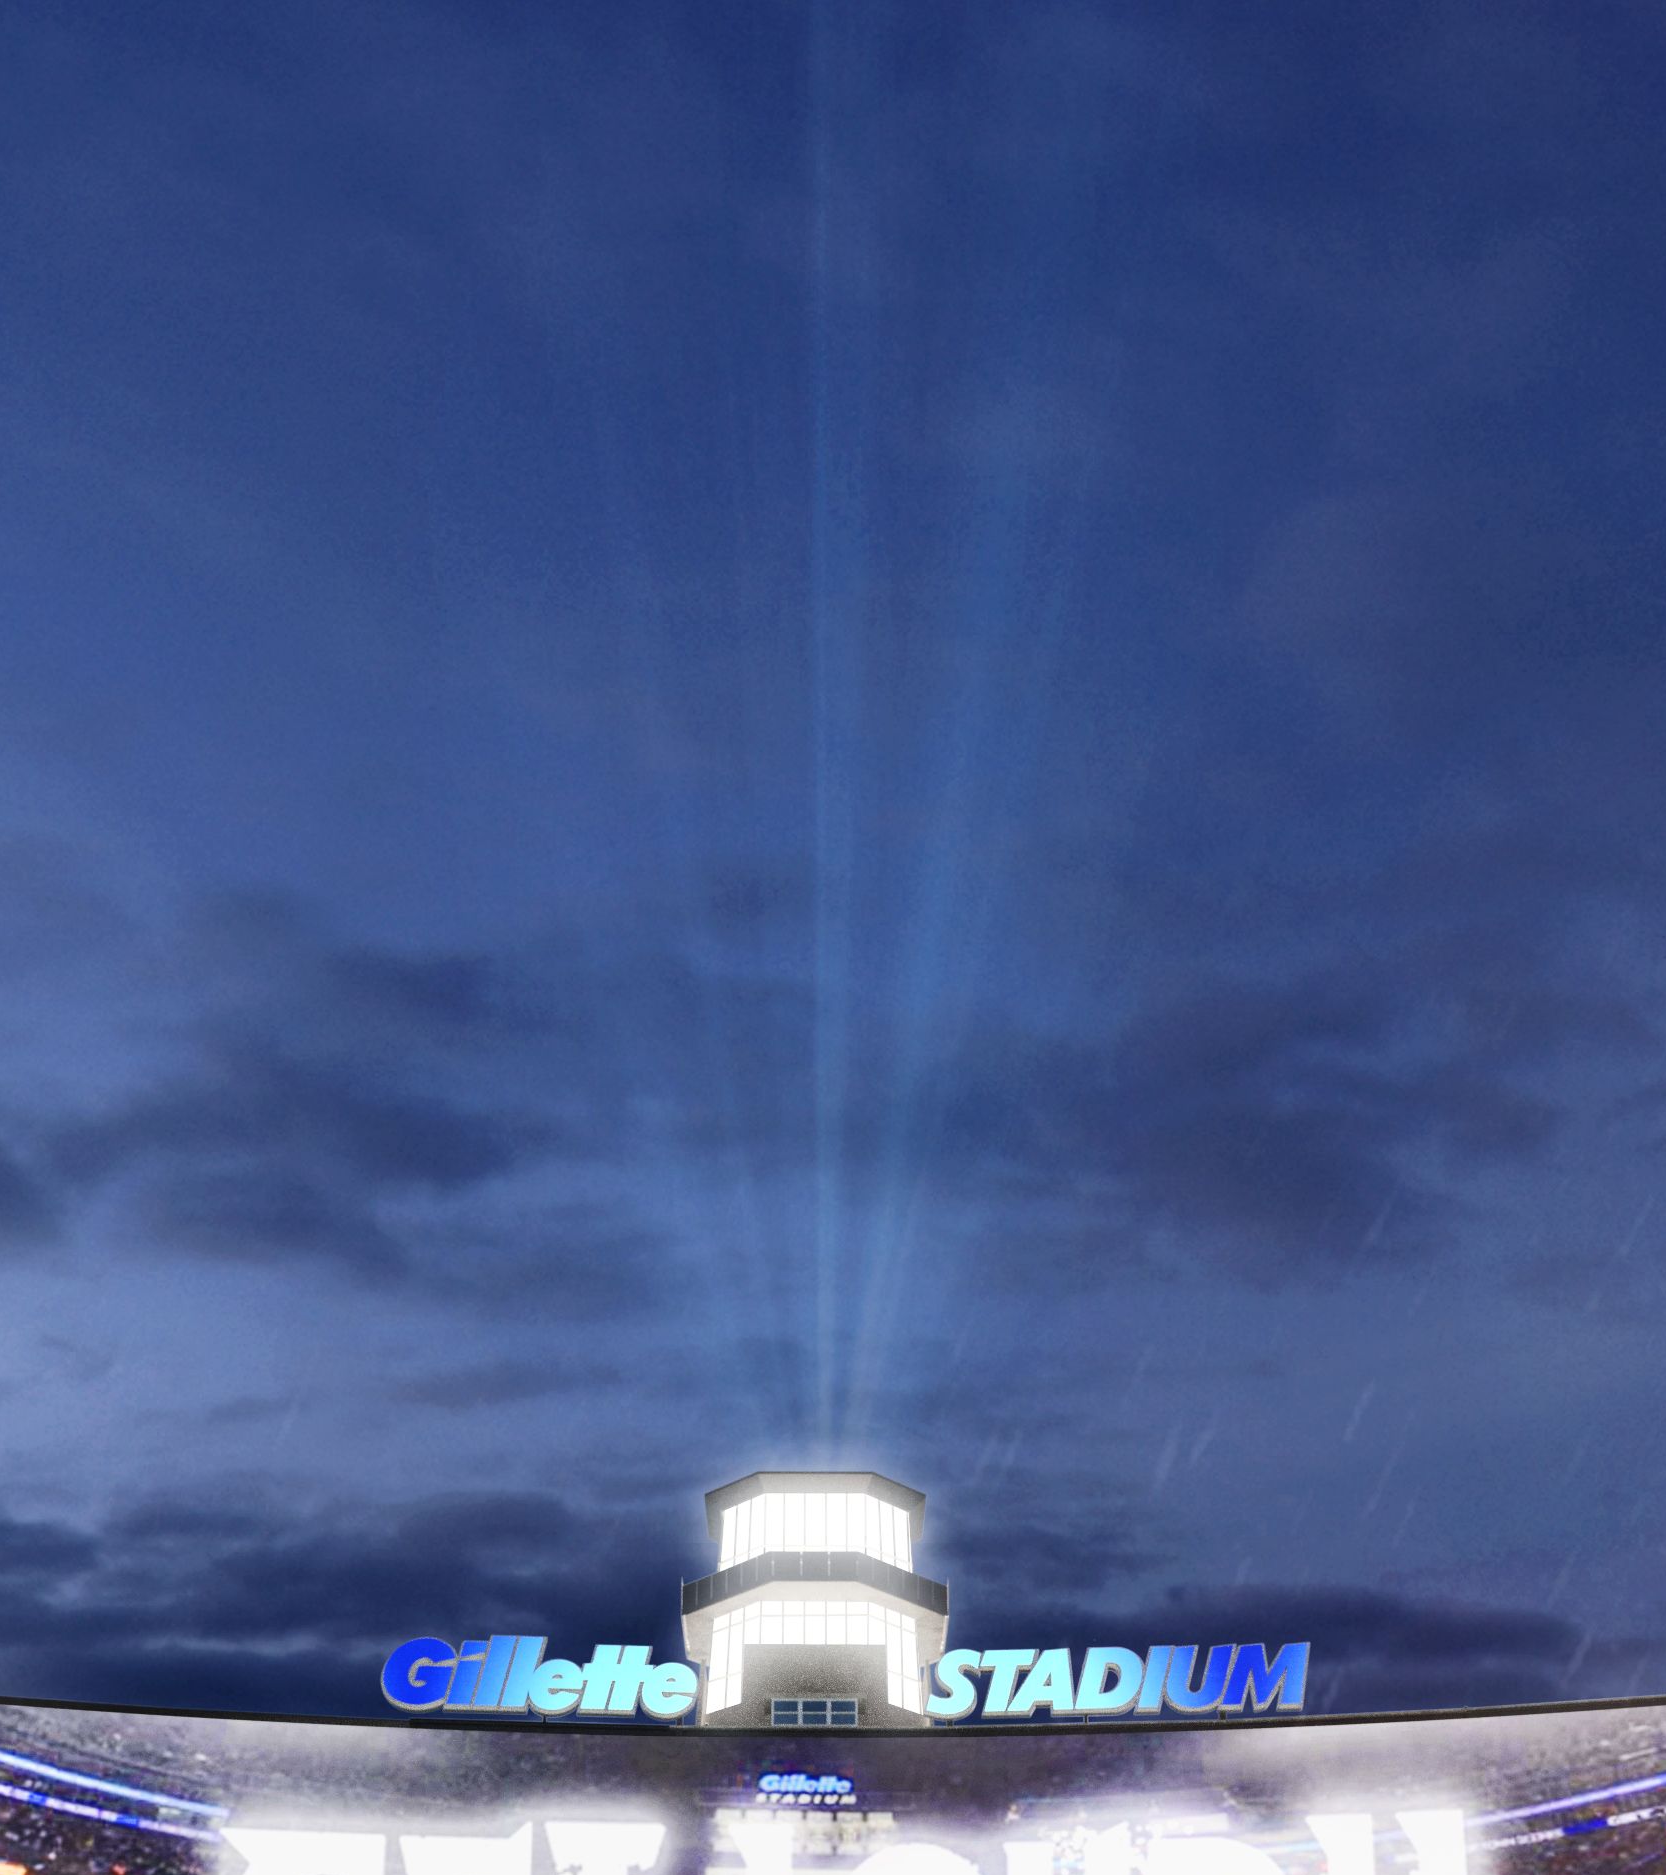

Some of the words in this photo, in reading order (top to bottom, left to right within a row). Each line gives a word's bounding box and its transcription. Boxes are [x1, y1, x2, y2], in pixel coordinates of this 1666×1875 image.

[380, 1635, 699, 1720] Gillette
[926, 1641, 1309, 1721] STADIUM
[759, 1772, 853, 1793] Gillette
[755, 1793, 857, 1805] STADIUM
